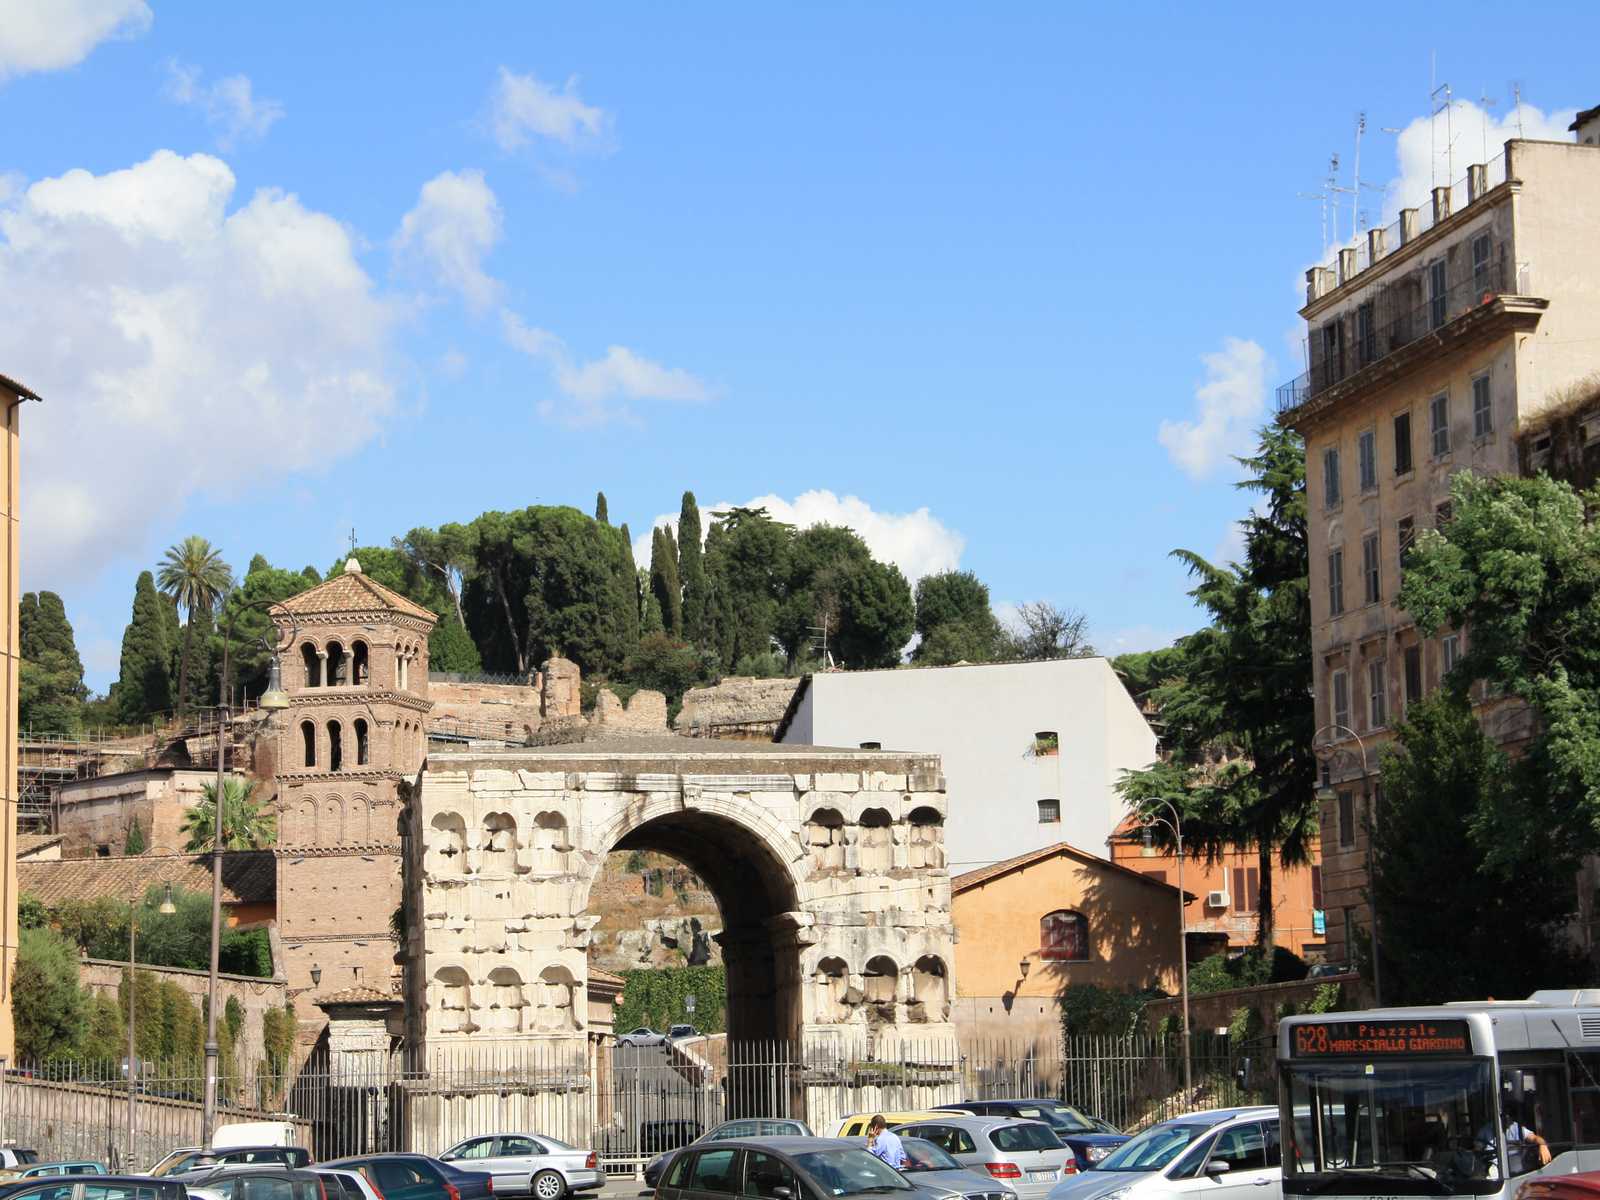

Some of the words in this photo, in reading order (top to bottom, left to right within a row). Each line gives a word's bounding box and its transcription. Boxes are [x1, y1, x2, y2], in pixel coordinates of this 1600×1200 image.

[1360, 1024, 1437, 1037] Piazzale
[1297, 1026, 1328, 1052] 628
[1329, 1039, 1406, 1051] MARESCIALLO
